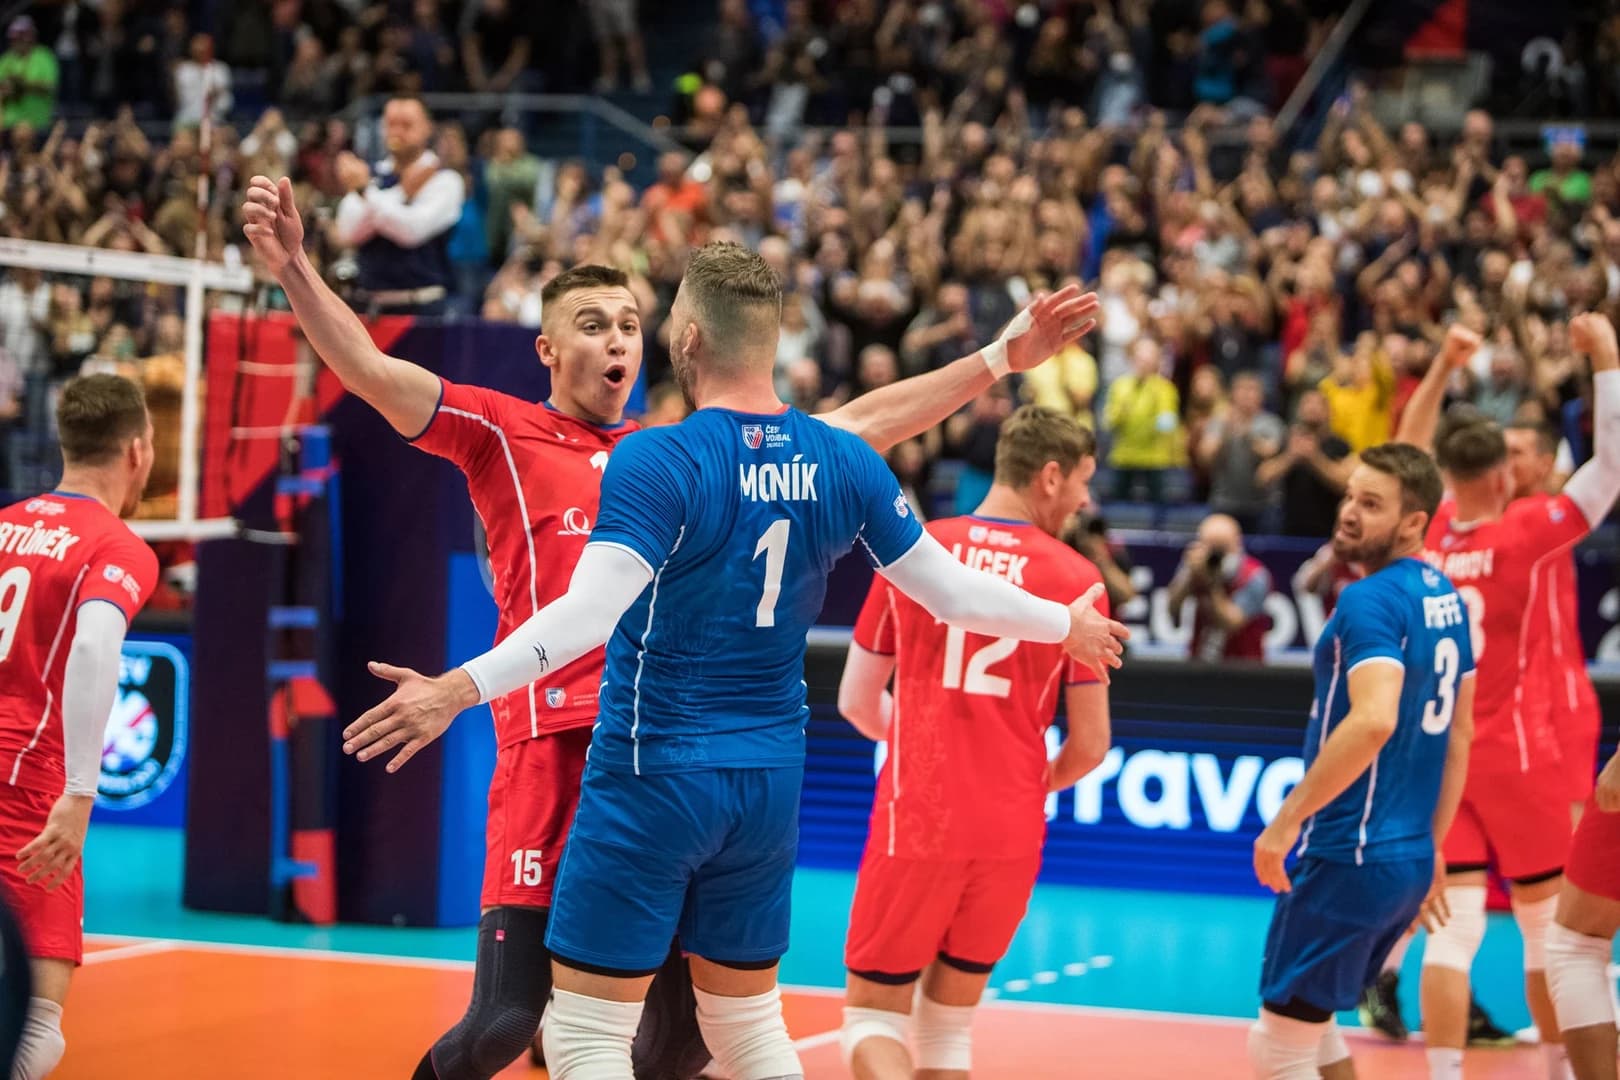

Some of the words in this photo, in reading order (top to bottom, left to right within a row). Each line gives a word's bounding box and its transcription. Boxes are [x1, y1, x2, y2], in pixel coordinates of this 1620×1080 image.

[740, 453, 818, 502] MONÍK
[752, 519, 790, 627] 1
[935, 620, 1020, 698] 12
[1421, 637, 1459, 735] 3
[511, 849, 542, 886] 15
